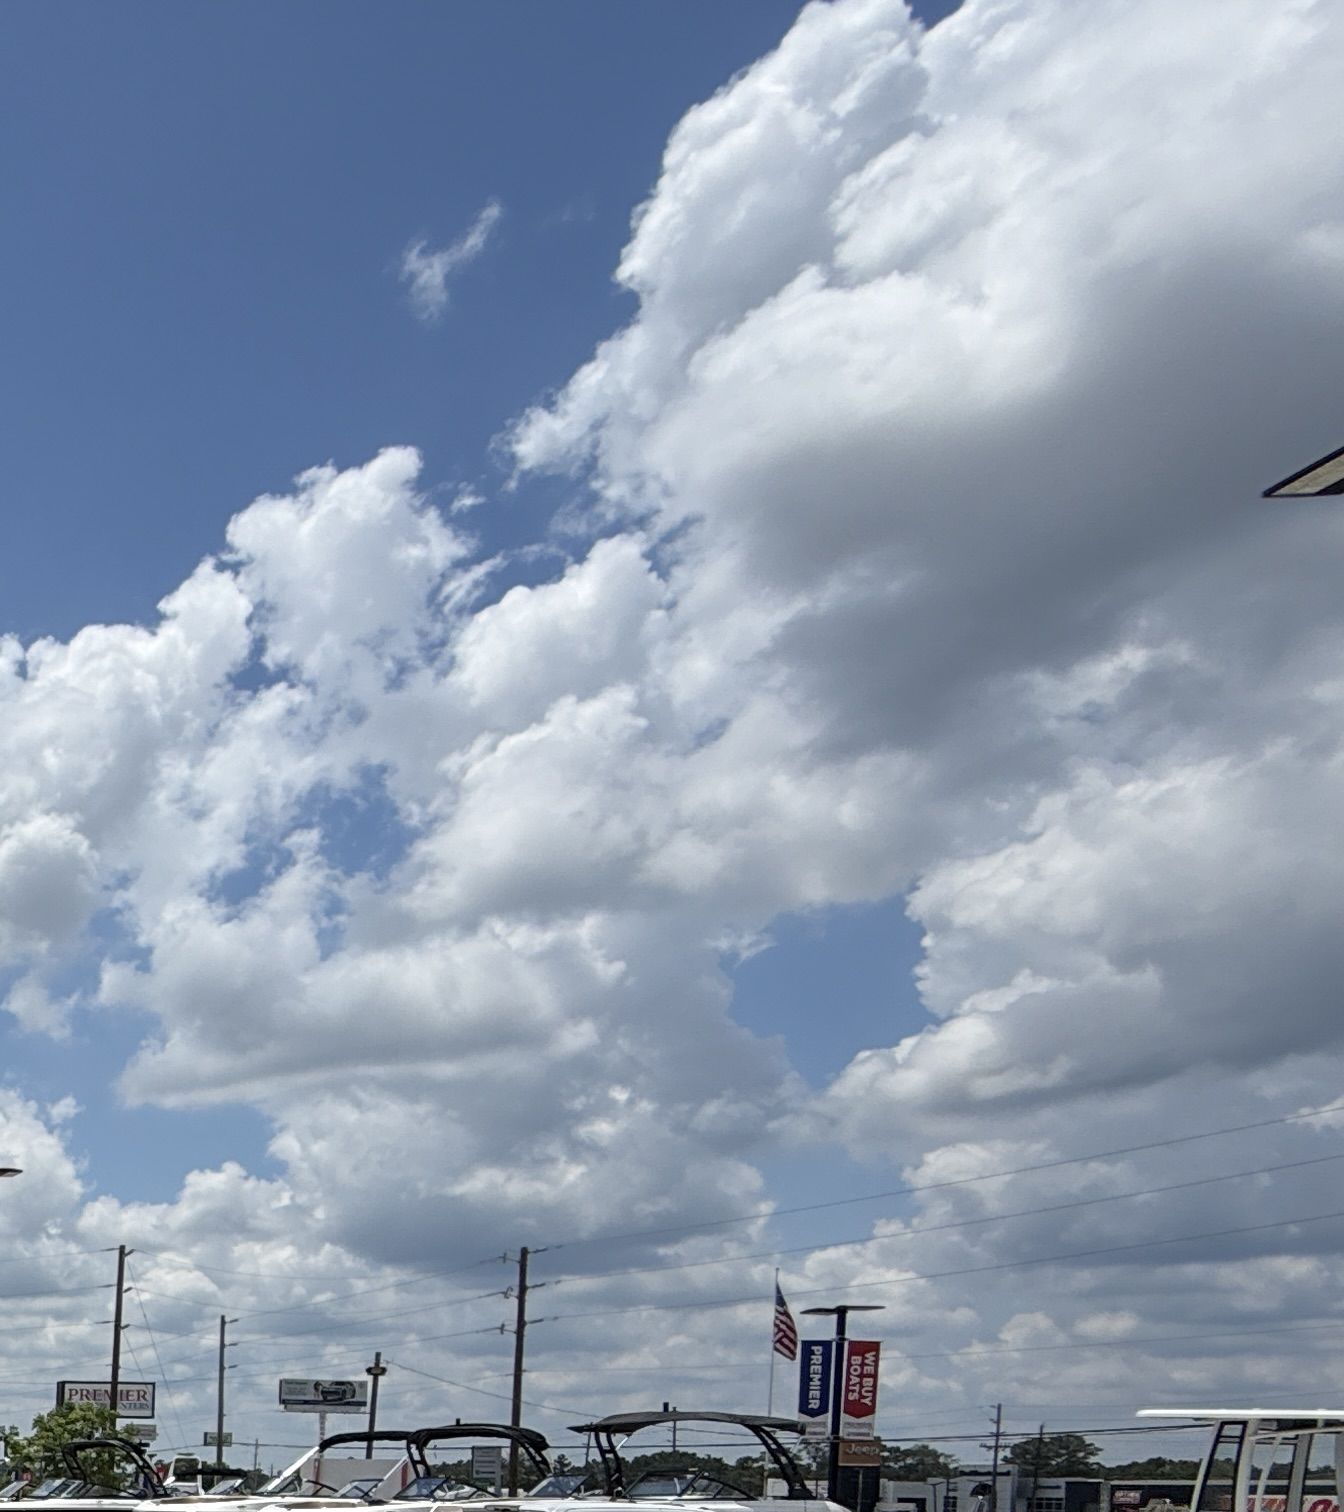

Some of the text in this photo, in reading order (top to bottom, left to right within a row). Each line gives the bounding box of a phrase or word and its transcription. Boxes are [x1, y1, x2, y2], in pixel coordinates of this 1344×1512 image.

[808, 1345, 823, 1409] PREMIER
[847, 1355, 862, 1401] BOATS
[860, 1351, 877, 1406] WE BUY
[119, 1402, 151, 1410] NTERS
[845, 1443, 880, 1456] Jeep
